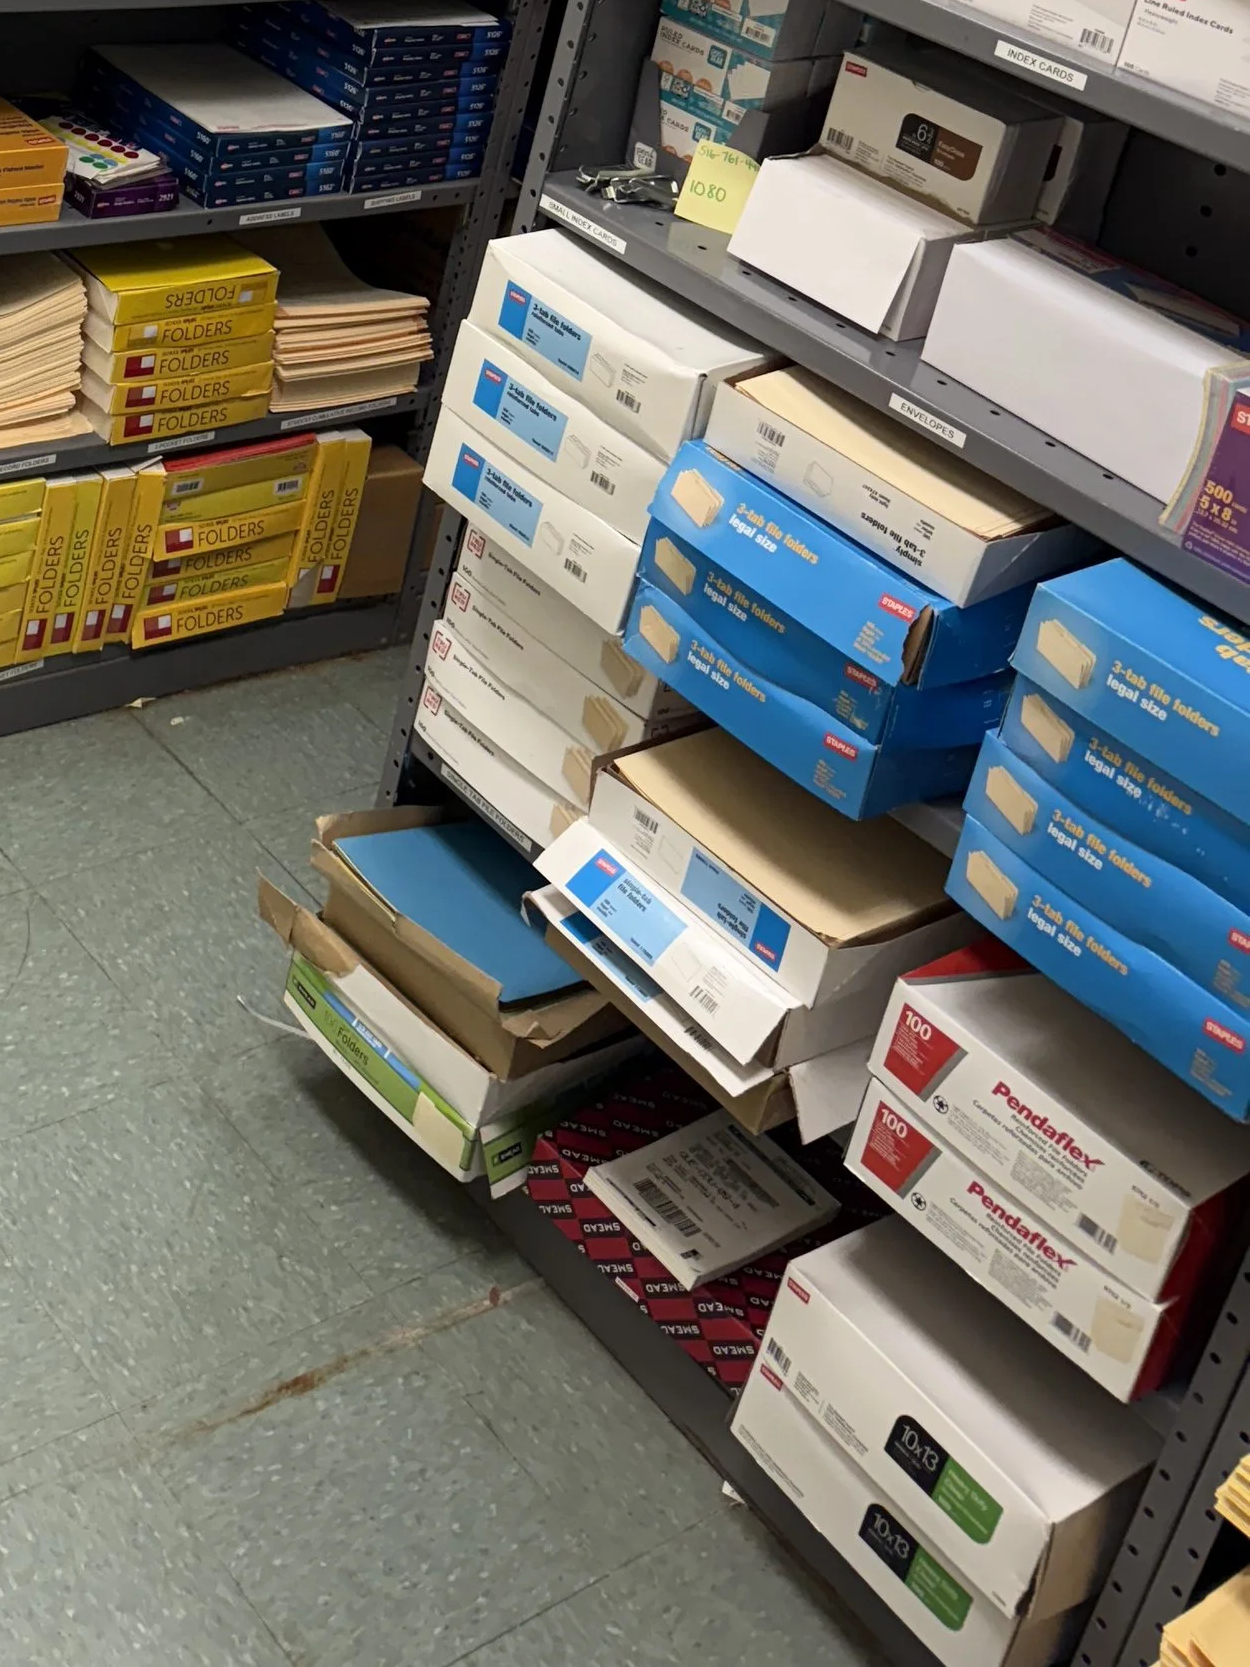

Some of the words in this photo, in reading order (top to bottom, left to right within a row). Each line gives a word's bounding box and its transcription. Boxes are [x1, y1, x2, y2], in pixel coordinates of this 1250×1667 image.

[1161, 2, 1186, 16] Ruled
[1185, 11, 1209, 25] Index
[1208, 19, 1234, 34] Cards
[1007, 48, 1039, 69] INDEX
[1039, 60, 1074, 82] CARDS
[689, 180, 727, 202] 1080
[571, 213, 594, 233] INDEX
[594, 226, 617, 247] CARDS
[165, 284, 235, 308] FOLDERS
[162, 320, 233, 344] FOLDERS
[159, 351, 230, 374] FOLDERS
[159, 381, 230, 405] FOLDERS
[158, 407, 228, 433] FOLDERS
[900, 401, 955, 439] ENVELOPES
[1199, 496, 1209, 510] 5
[1221, 506, 1231, 521] 8
[1204, 480, 1234, 504] 500
[729, 514, 756, 539] legal
[754, 529, 778, 553] size
[736, 502, 766, 528] 3-tab
[766, 519, 784, 540] file
[783, 530, 819, 565] folders
[893, 544, 924, 568] simply
[882, 596, 914, 619] STAPLES
[687, 652, 711, 677] legal
[710, 666, 730, 690] size
[1107, 674, 1139, 708] legal
[1139, 693, 1168, 722] size
[1112, 660, 1148, 692] 3-tab
[1148, 680, 1171, 706] file
[1171, 691, 1220, 737] folders
[470, 793, 481, 805] TAB
[481, 802, 494, 816] FILE
[495, 815, 524, 843] FOLDERS
[1047, 824, 1079, 855] legal
[1077, 843, 1103, 871] size
[1052, 809, 1086, 839] 3-tab
[1085, 827, 1107, 853] file
[1107, 842, 1151, 888] folders
[904, 1010, 932, 1041] 100
[336, 1026, 370, 1067] Folders
[880, 1107, 908, 1139] 100
[990, 1078, 1105, 1178] Pendaflex
[583, 1223, 620, 1233] SMEAD
[965, 1178, 1077, 1276] Pendaflex
[645, 1282, 685, 1293] SMEAD
[713, 1345, 754, 1355] SMEAD
[902, 1425, 940, 1472] 10x13
[873, 1513, 910, 1560] 10x13
